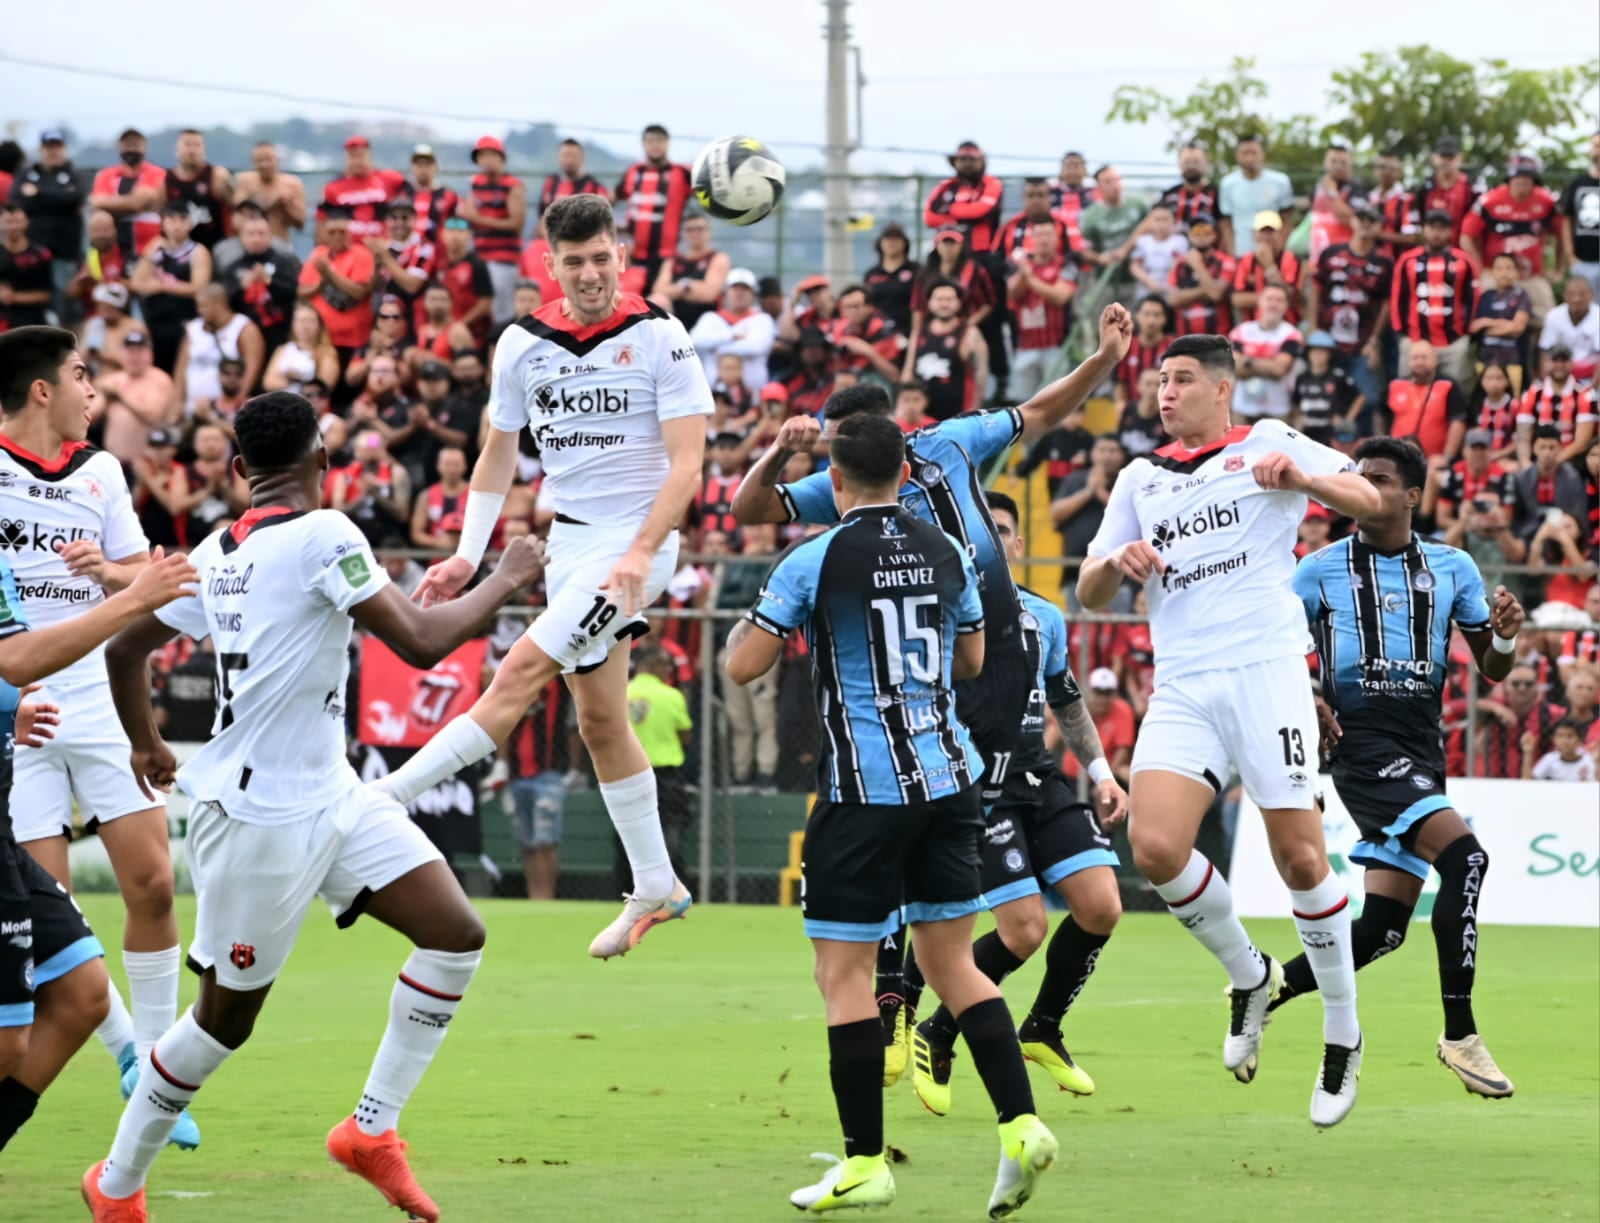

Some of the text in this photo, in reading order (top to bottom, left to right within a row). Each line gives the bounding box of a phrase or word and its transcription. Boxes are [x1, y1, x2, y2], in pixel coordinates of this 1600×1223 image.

[561, 387, 628, 413] kölbi
[45, 487, 72, 501] BAC
[1176, 500, 1240, 540] kölbi
[872, 566, 935, 589] CHEVEZ
[1173, 551, 1248, 591] medismart
[578, 595, 618, 638] 19
[870, 594, 941, 687] 15
[1278, 726, 1306, 767] 13
[1526, 832, 1599, 878] Se
[1461, 851, 1485, 968] SANTA ANA
